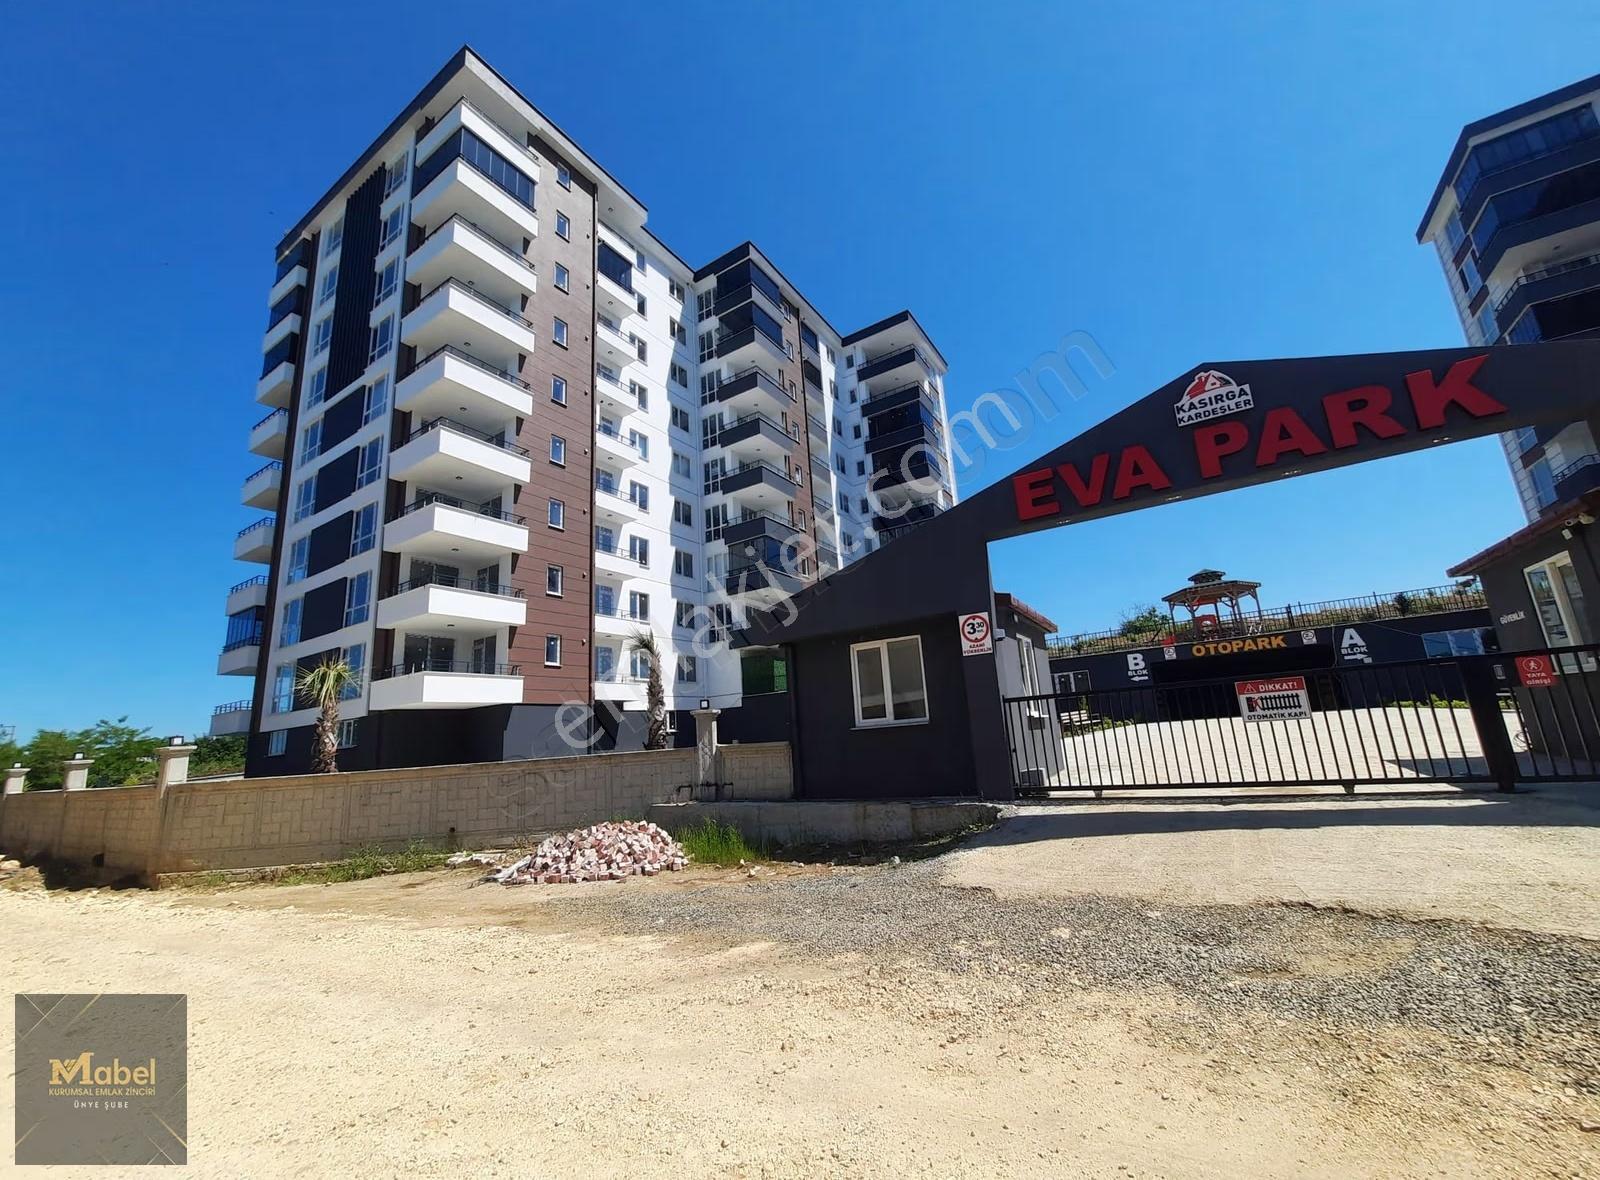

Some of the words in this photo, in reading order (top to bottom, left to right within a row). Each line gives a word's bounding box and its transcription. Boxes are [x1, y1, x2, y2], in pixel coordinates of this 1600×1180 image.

[1175, 387, 1249, 415] KASIRGA
[1012, 445, 1173, 522] EVA
[1193, 354, 1508, 480] PARK
[1192, 635, 1288, 657] OTOPARK
[1341, 628, 1366, 648] A
[1341, 646, 1368, 655] BLOK
[1126, 653, 1146, 671] B
[1127, 669, 1149, 677] BLOK
[1259, 681, 1298, 692] DİKKAT!
[1247, 712, 1287, 721] OTOMATİK
[1287, 711, 1307, 719] KAPI
